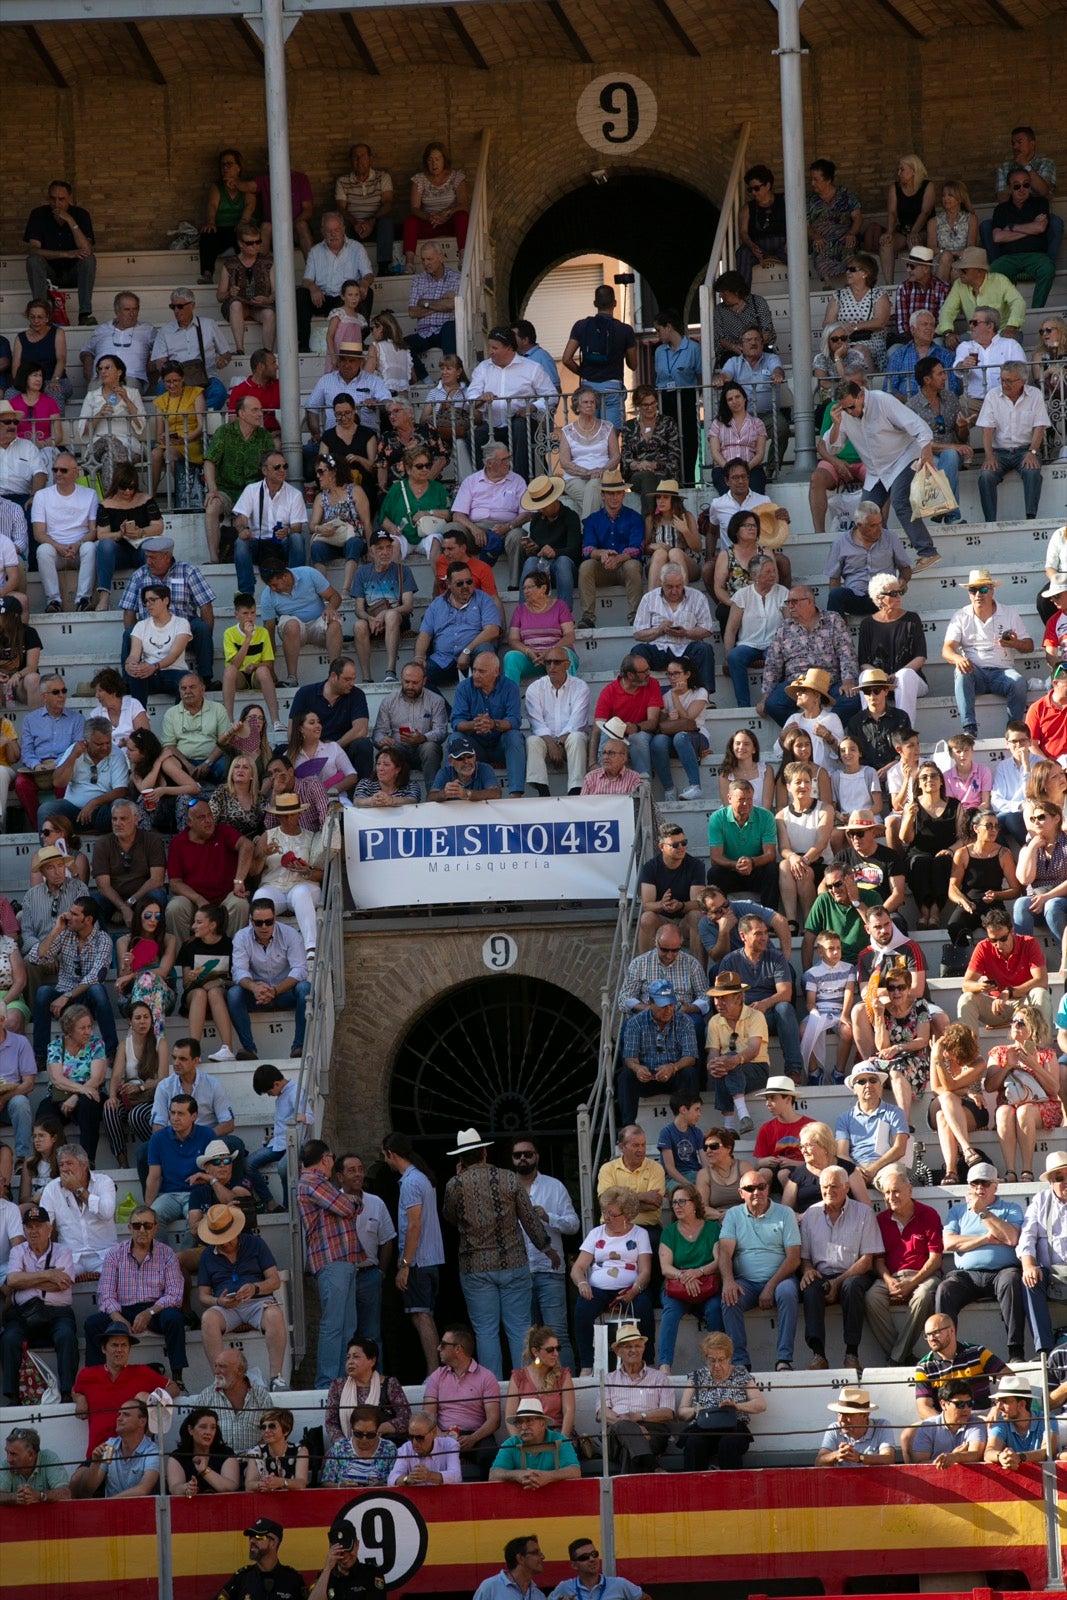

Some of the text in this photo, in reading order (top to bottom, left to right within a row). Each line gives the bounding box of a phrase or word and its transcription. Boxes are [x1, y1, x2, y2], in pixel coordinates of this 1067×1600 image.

[599, 81, 640, 144] 9
[966, 536, 981, 545] 25
[1032, 531, 1048, 541] 26
[940, 578, 957, 588] 24
[1011, 575, 1027, 585] 25
[112, 581, 125, 590] 12
[600, 599, 613, 609] 19
[62, 625, 73, 634] 11
[922, 623, 936, 633] 24
[585, 640, 597, 651] 19
[1024, 660, 1040, 670] 25
[749, 676, 763, 686] 21
[748, 720, 762, 730] 21
[989, 751, 1005, 762] 24
[15, 846, 30, 856] 10
[428, 859, 550, 873] Marisquería
[491, 936, 511, 967] 9
[202, 1027, 217, 1039] 12
[794, 1100, 808, 1111] 16
[653, 1107, 667, 1117] 14
[1033, 1142, 1048, 1152] 18
[361, 1507, 397, 1574] 9
